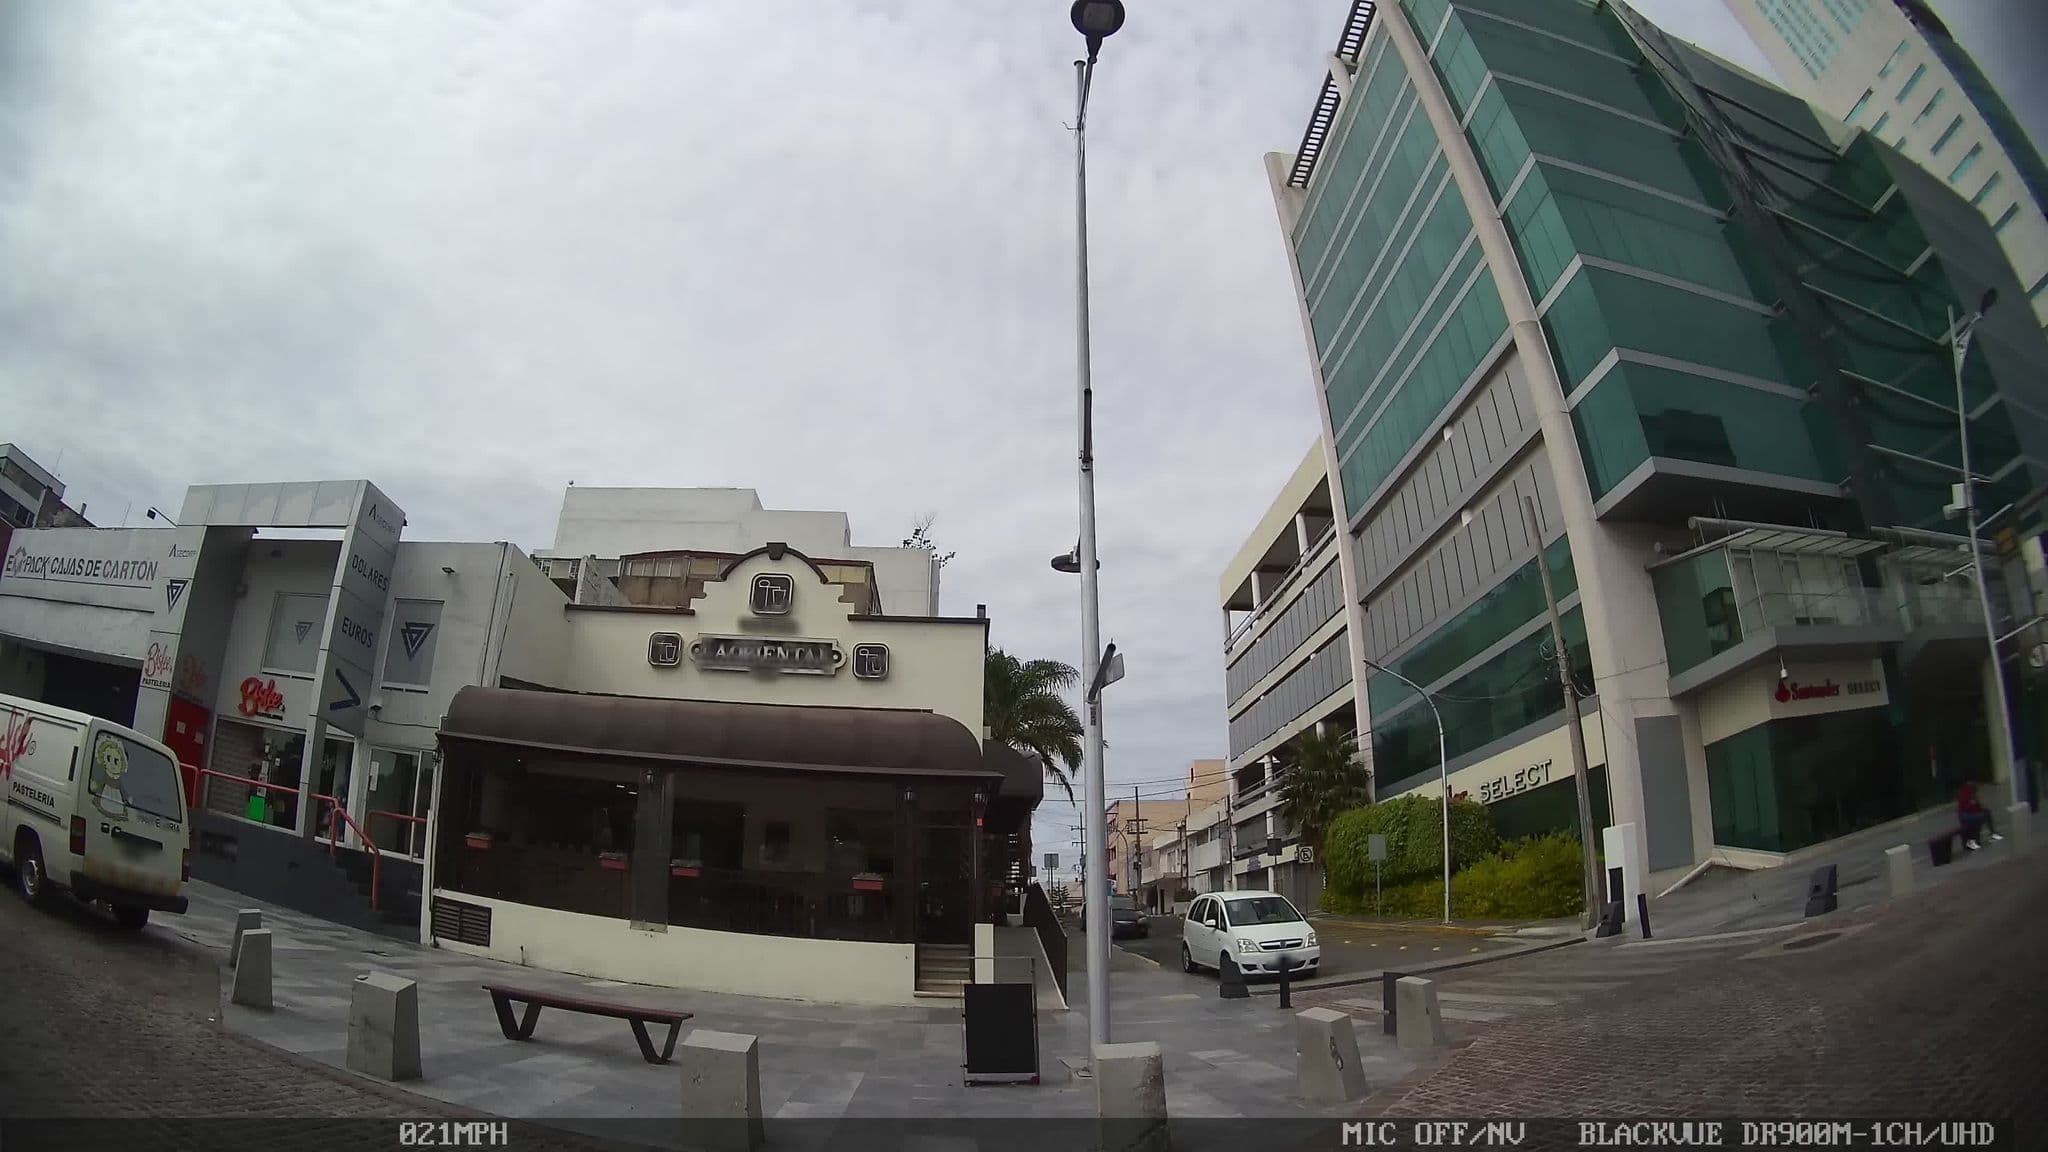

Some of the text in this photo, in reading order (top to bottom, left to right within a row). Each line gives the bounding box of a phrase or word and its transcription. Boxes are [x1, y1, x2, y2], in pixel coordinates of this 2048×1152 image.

[50, 557, 84, 576] CAJAS
[84, 560, 101, 577] DE
[102, 560, 158, 580] CARTON
[352, 554, 389, 592] DOLARES
[342, 616, 373, 648] EUROS
[12, 781, 55, 808] PASTELERIA
[1480, 759, 1552, 802] SELECT
